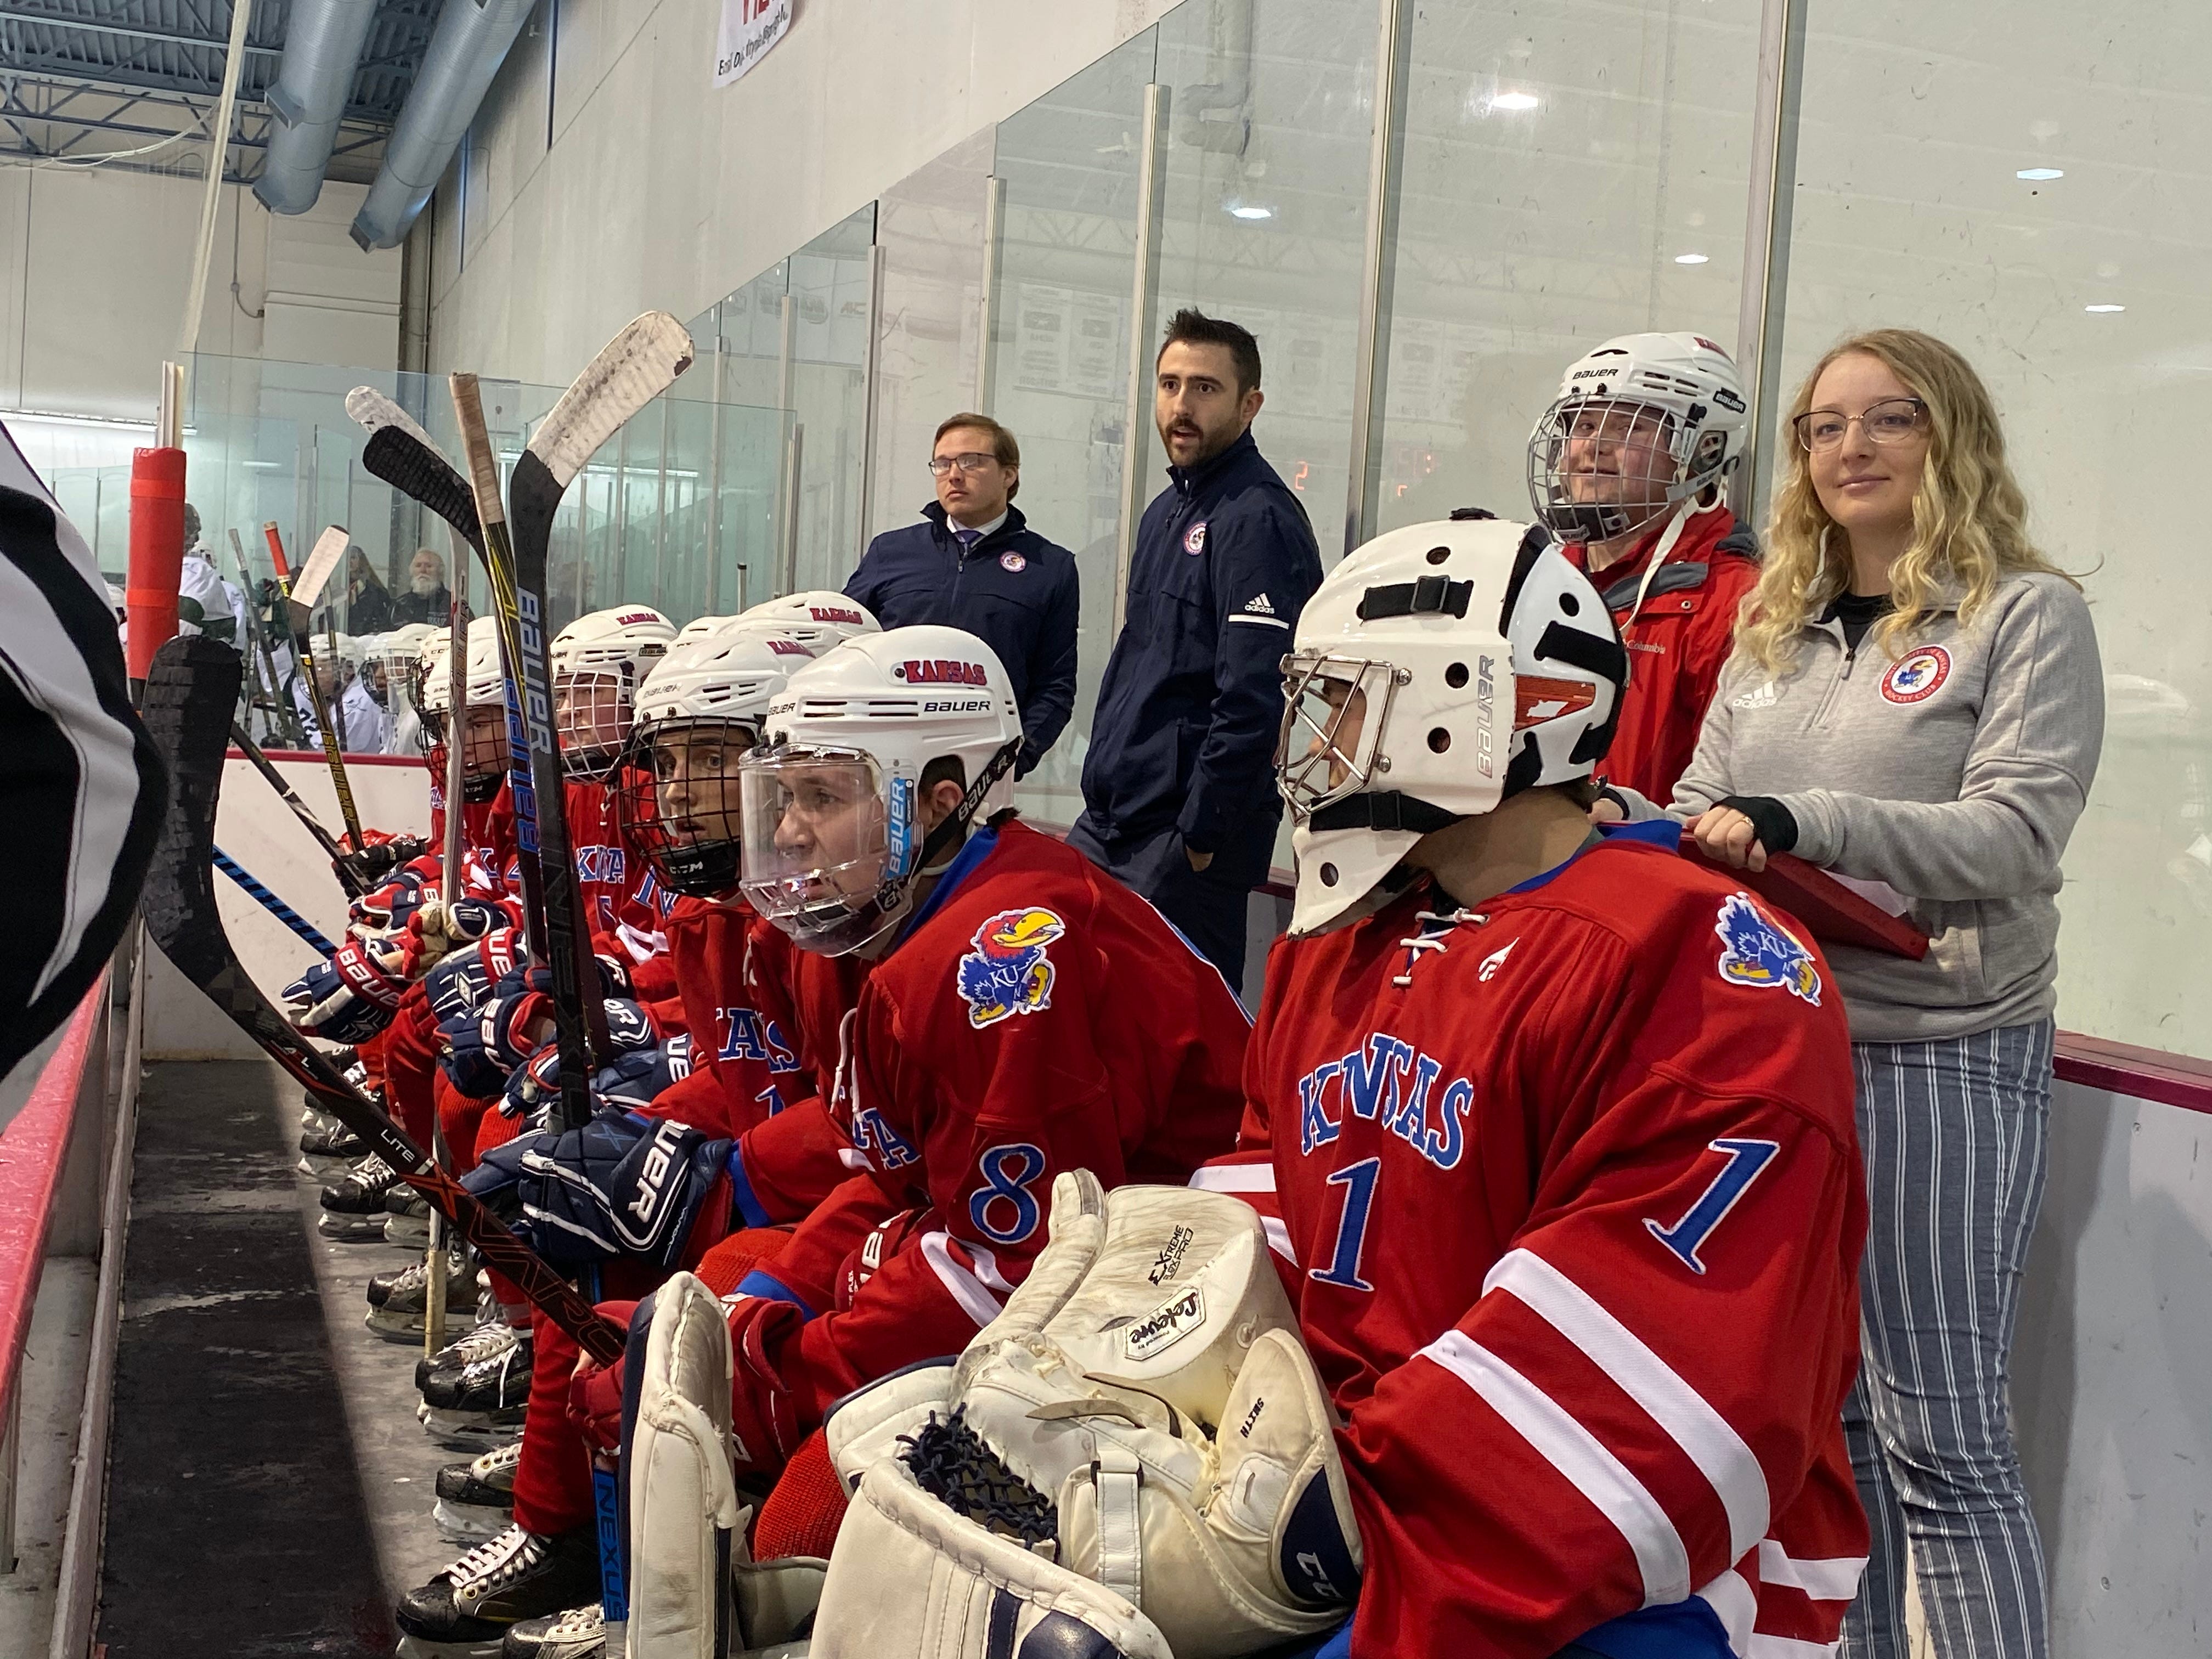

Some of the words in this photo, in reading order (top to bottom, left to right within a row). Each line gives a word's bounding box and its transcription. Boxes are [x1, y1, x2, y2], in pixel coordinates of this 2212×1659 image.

[1572, 368, 1619, 380] BAUER
[1244, 603, 1275, 614] adidas
[518, 586, 552, 755] BAUER
[902, 659, 988, 686] KANSAS
[924, 701, 991, 713] BAUER
[1476, 655, 1495, 779] BAUER
[1732, 697, 1778, 710] adidas
[889, 779, 905, 874] BAUER
[1757, 930, 1788, 960] KU
[338, 949, 401, 1008] BAUE
[988, 964, 1019, 989] KU
[1298, 1032, 1474, 1171] KNSAS
[380, 1128, 415, 1164] LITE
[969, 1143, 1046, 1245] 8
[1643, 1138, 1781, 1275] 1
[1308, 1156, 1381, 1293] 1
[1148, 1224, 1184, 1286] EXTREME
[1240, 1397, 1264, 1439] SMITH
[1296, 1551, 1344, 1602] CC
